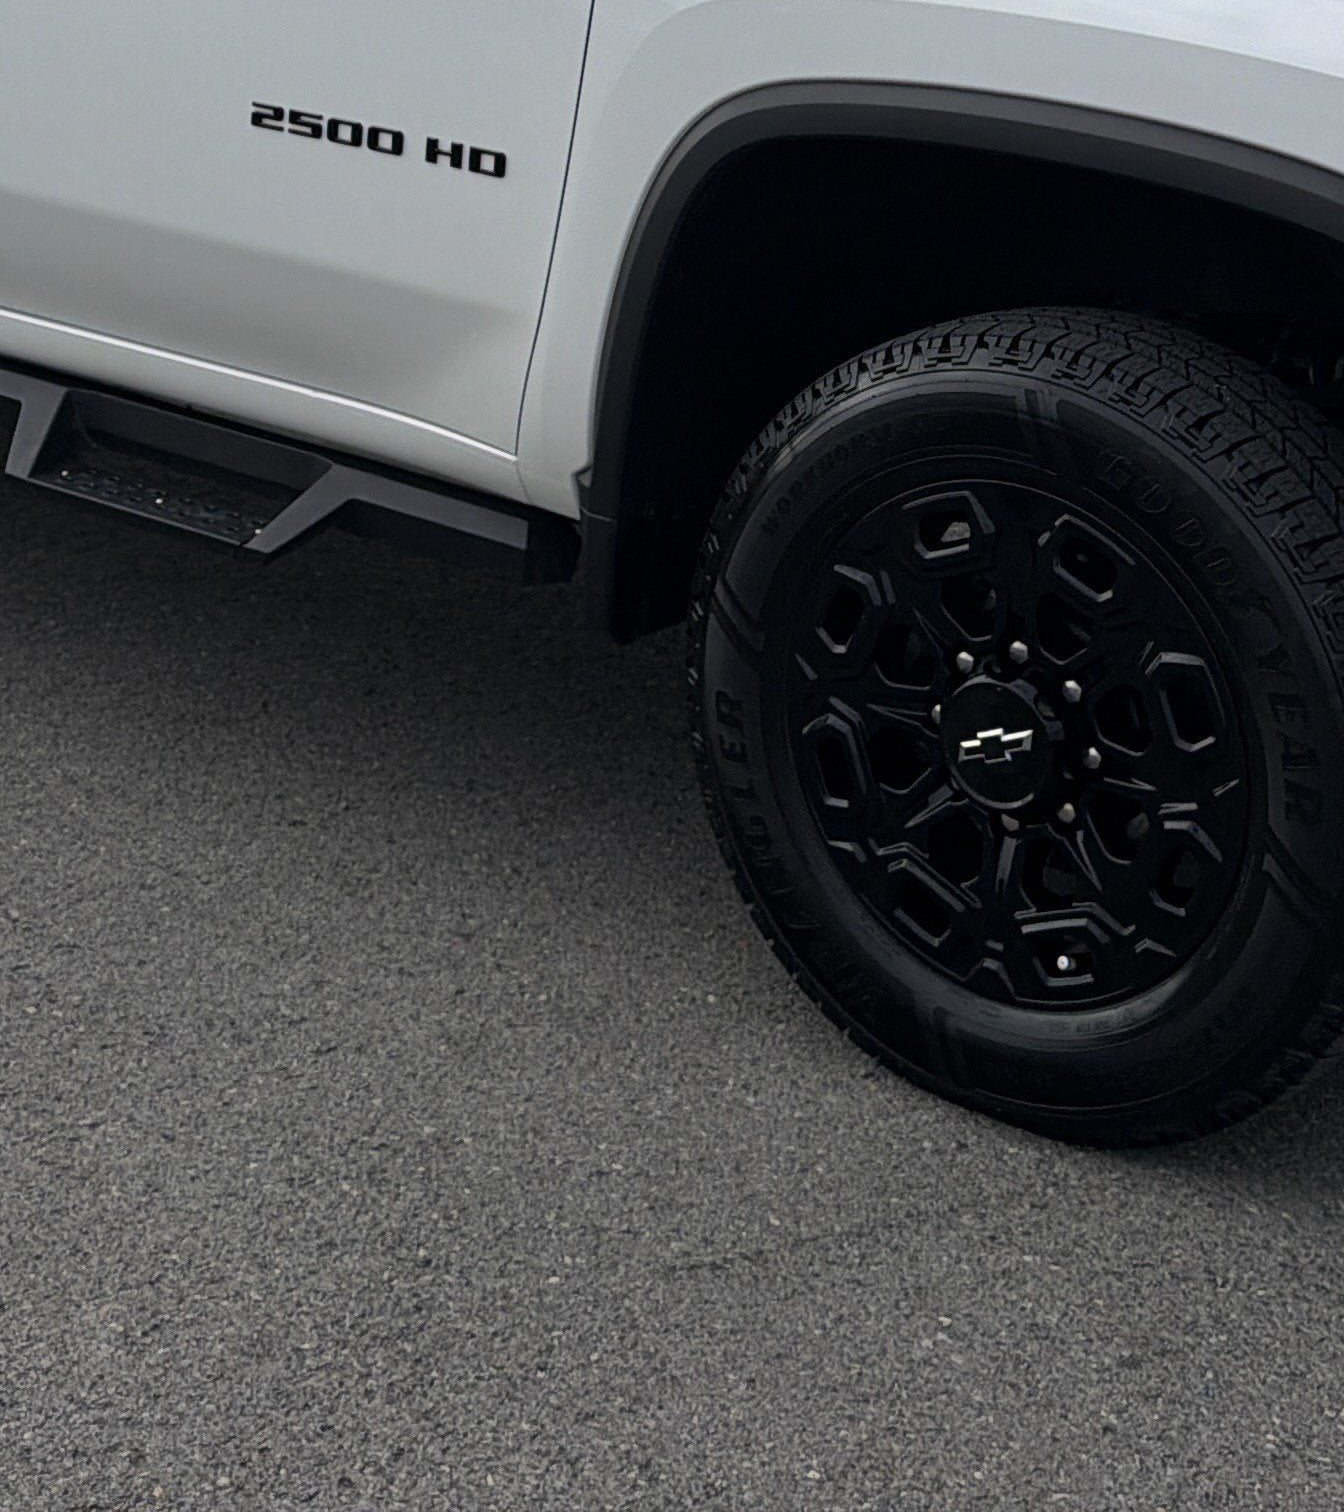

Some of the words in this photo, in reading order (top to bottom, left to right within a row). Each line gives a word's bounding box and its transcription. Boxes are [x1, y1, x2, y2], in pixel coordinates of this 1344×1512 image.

[251, 100, 405, 157] 2500
[425, 136, 507, 179] HD
[1095, 448, 1325, 829] GOODYEAR
